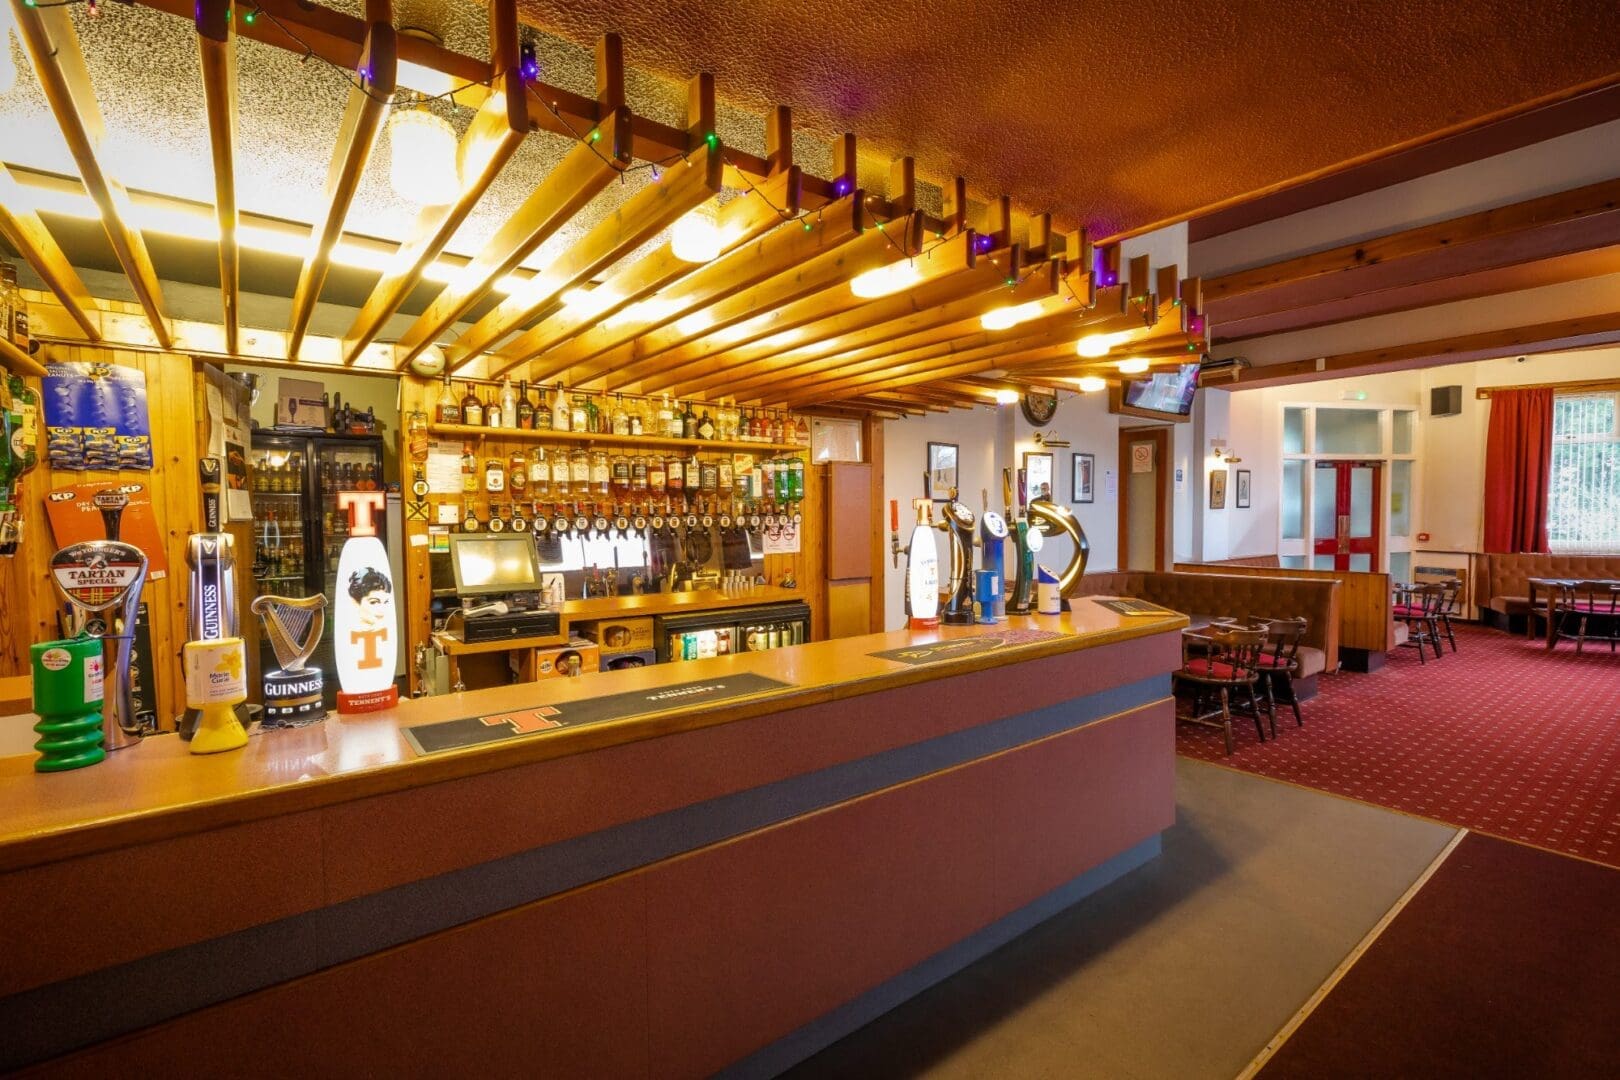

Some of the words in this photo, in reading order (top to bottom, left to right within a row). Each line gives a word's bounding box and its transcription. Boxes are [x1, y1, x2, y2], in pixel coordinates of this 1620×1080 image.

[51, 492, 74, 501] KP
[121, 484, 142, 494] KP
[208, 497, 217, 528] GUINNESS
[338, 490, 386, 536] T
[68, 569, 126, 580] TARTAN
[204, 584, 219, 639] GUINNESS
[350, 627, 388, 670] T
[478, 705, 563, 735] T
